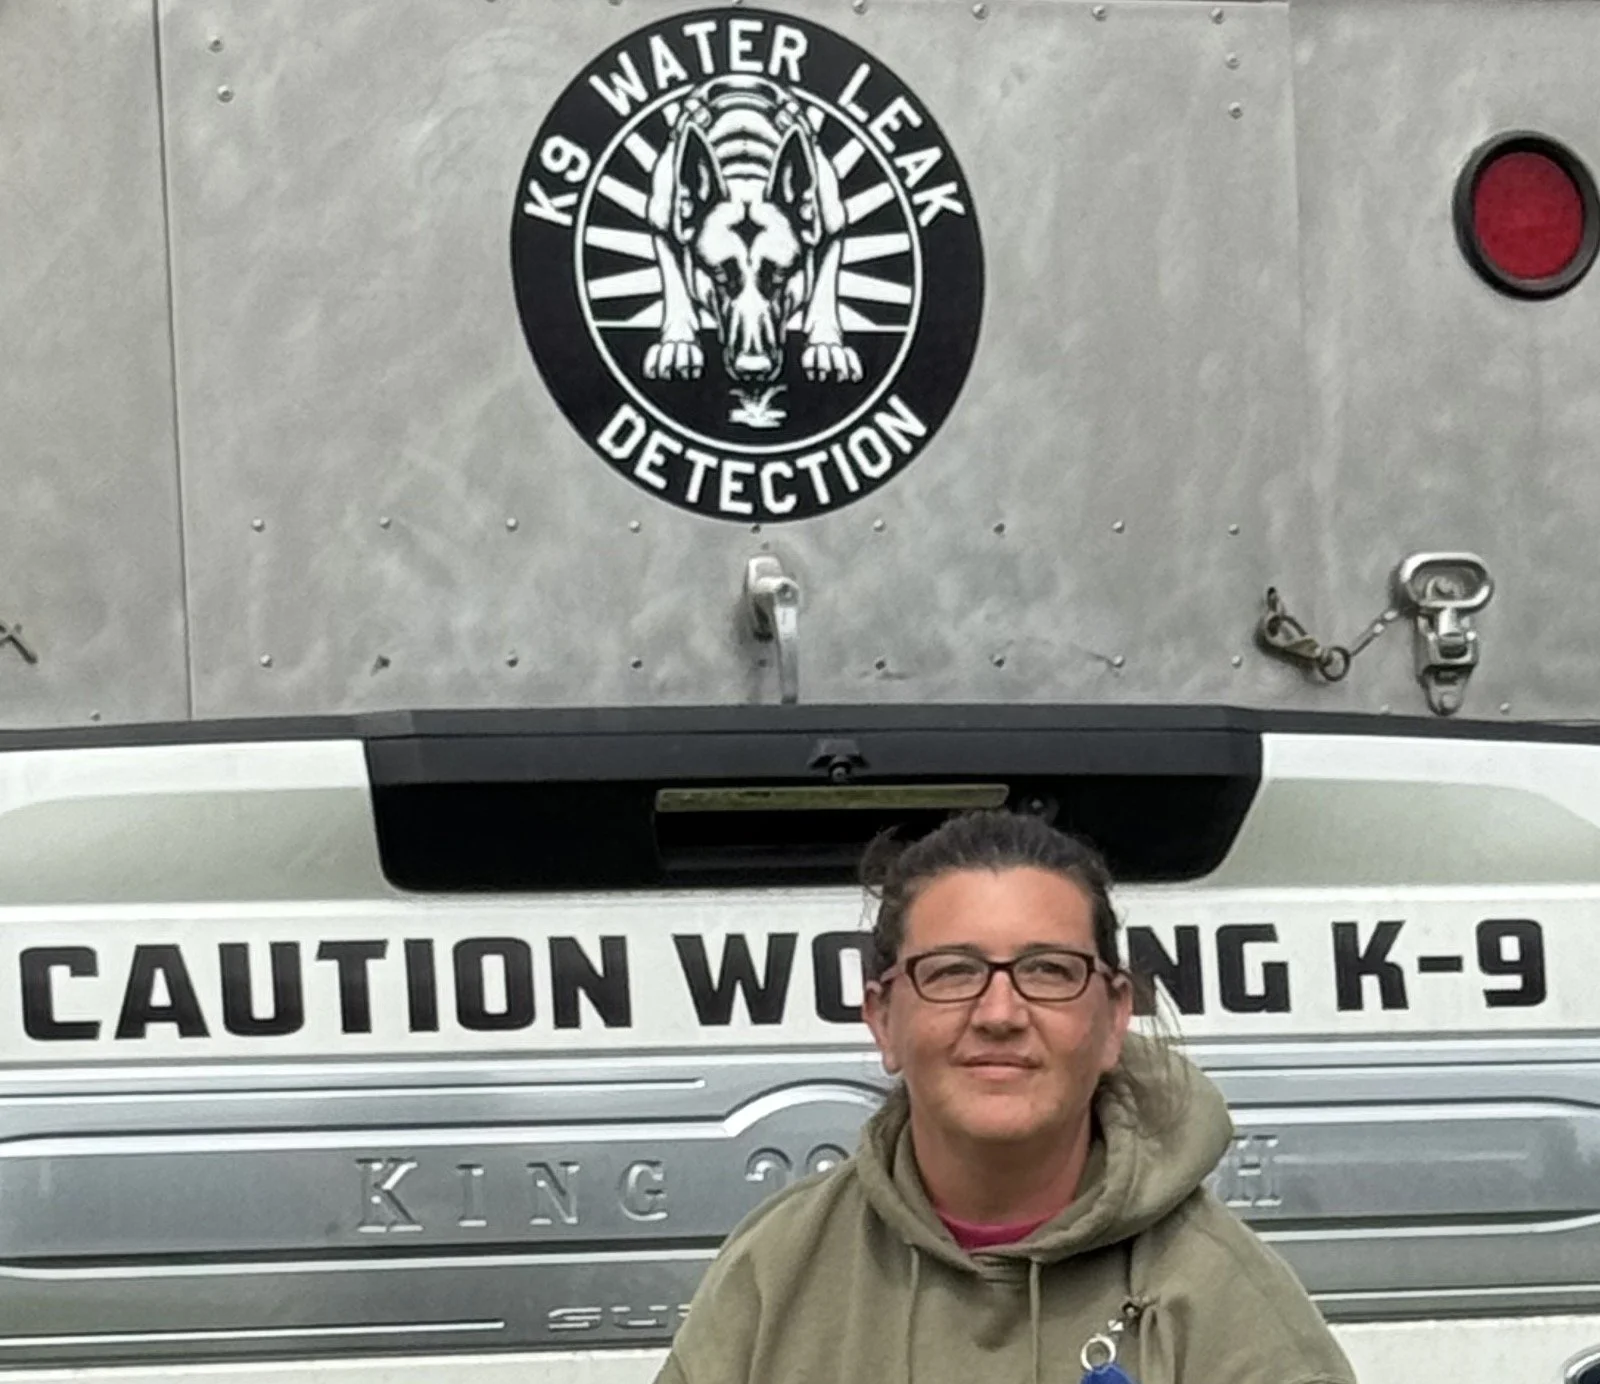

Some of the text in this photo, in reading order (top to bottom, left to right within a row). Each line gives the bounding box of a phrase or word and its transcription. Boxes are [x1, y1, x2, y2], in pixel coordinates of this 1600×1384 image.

[523, 18, 968, 228] K9 WATER LEAK
[596, 393, 928, 516] DETECTION
[18, 917, 1549, 1042] CAUTION WONG K-9
[354, 1156, 670, 1234] KING
